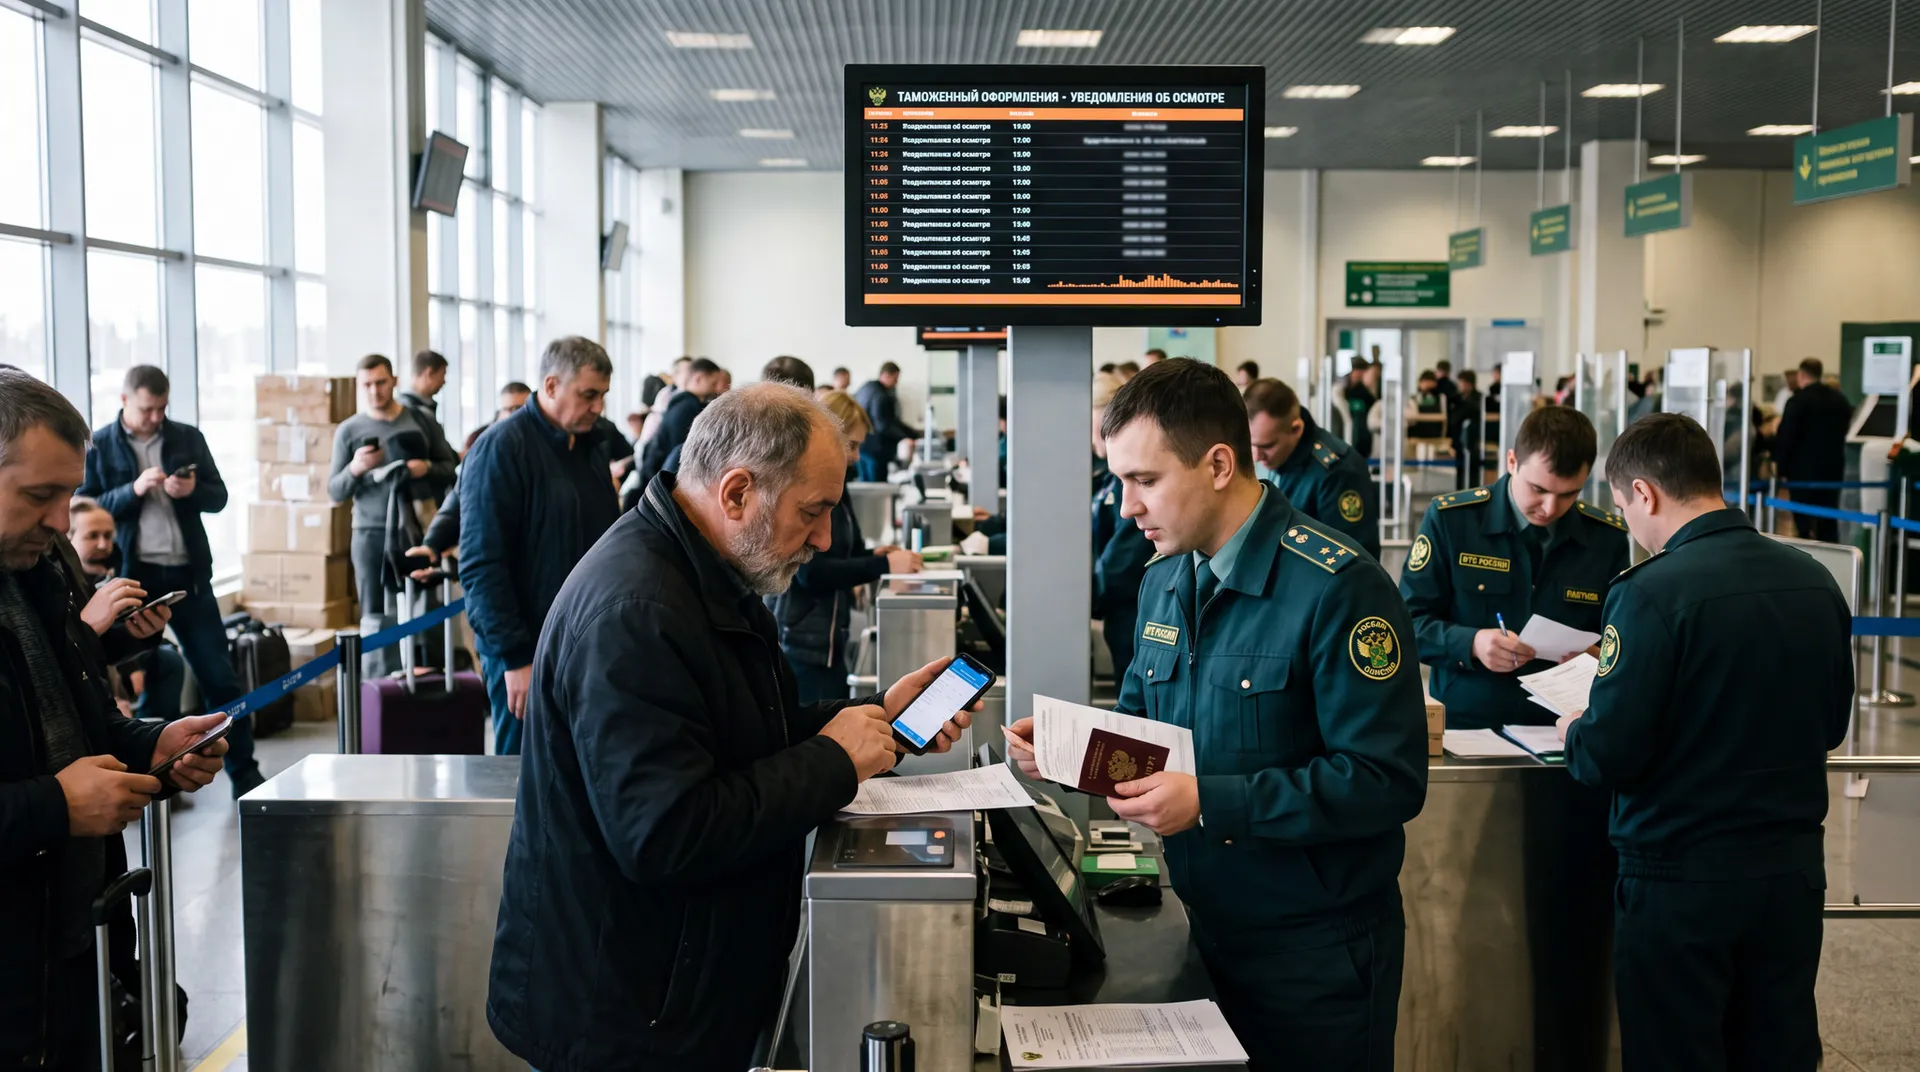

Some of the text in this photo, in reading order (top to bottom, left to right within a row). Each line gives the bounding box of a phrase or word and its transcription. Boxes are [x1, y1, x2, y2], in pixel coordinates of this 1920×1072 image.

[898, 89, 979, 103] ТАМОЖЕННЫЙ
[982, 91, 1059, 103] ОФОРМЛЕНИЯ
[1071, 91, 1153, 104] УВЕДОМЛЕНИЯ
[1155, 92, 1171, 103] ОБ
[1172, 92, 1225, 103] ОСМОТРЕ
